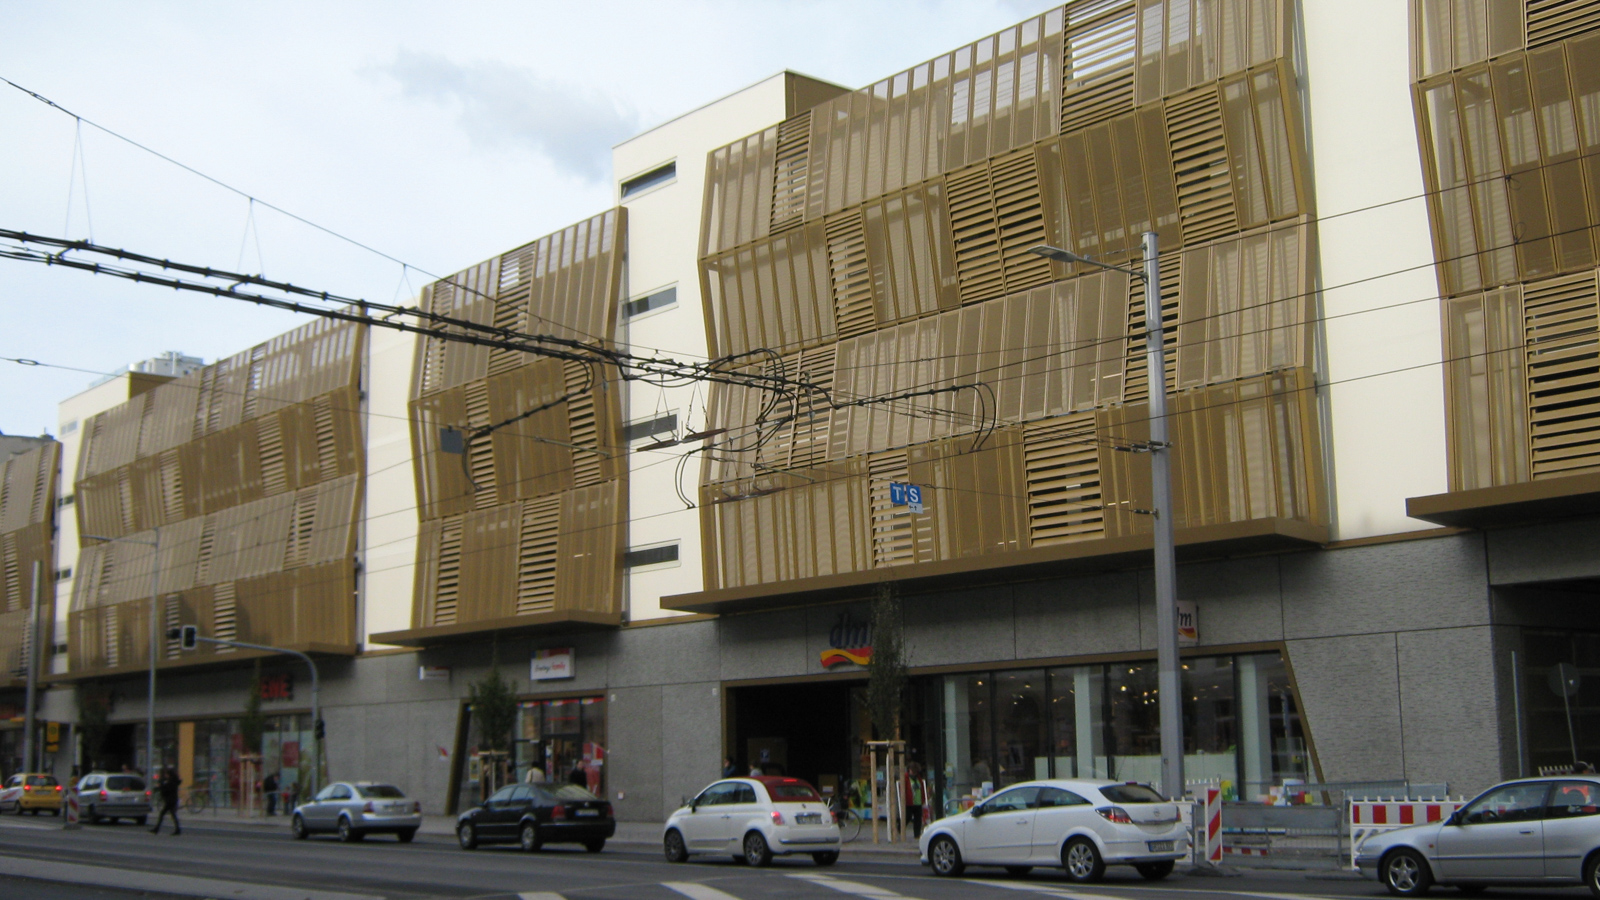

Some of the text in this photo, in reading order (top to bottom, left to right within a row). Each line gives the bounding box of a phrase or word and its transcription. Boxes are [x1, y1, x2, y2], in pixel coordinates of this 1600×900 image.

[892, 486, 919, 503] T S
[1176, 606, 1192, 627] m
[829, 612, 870, 648] dm
